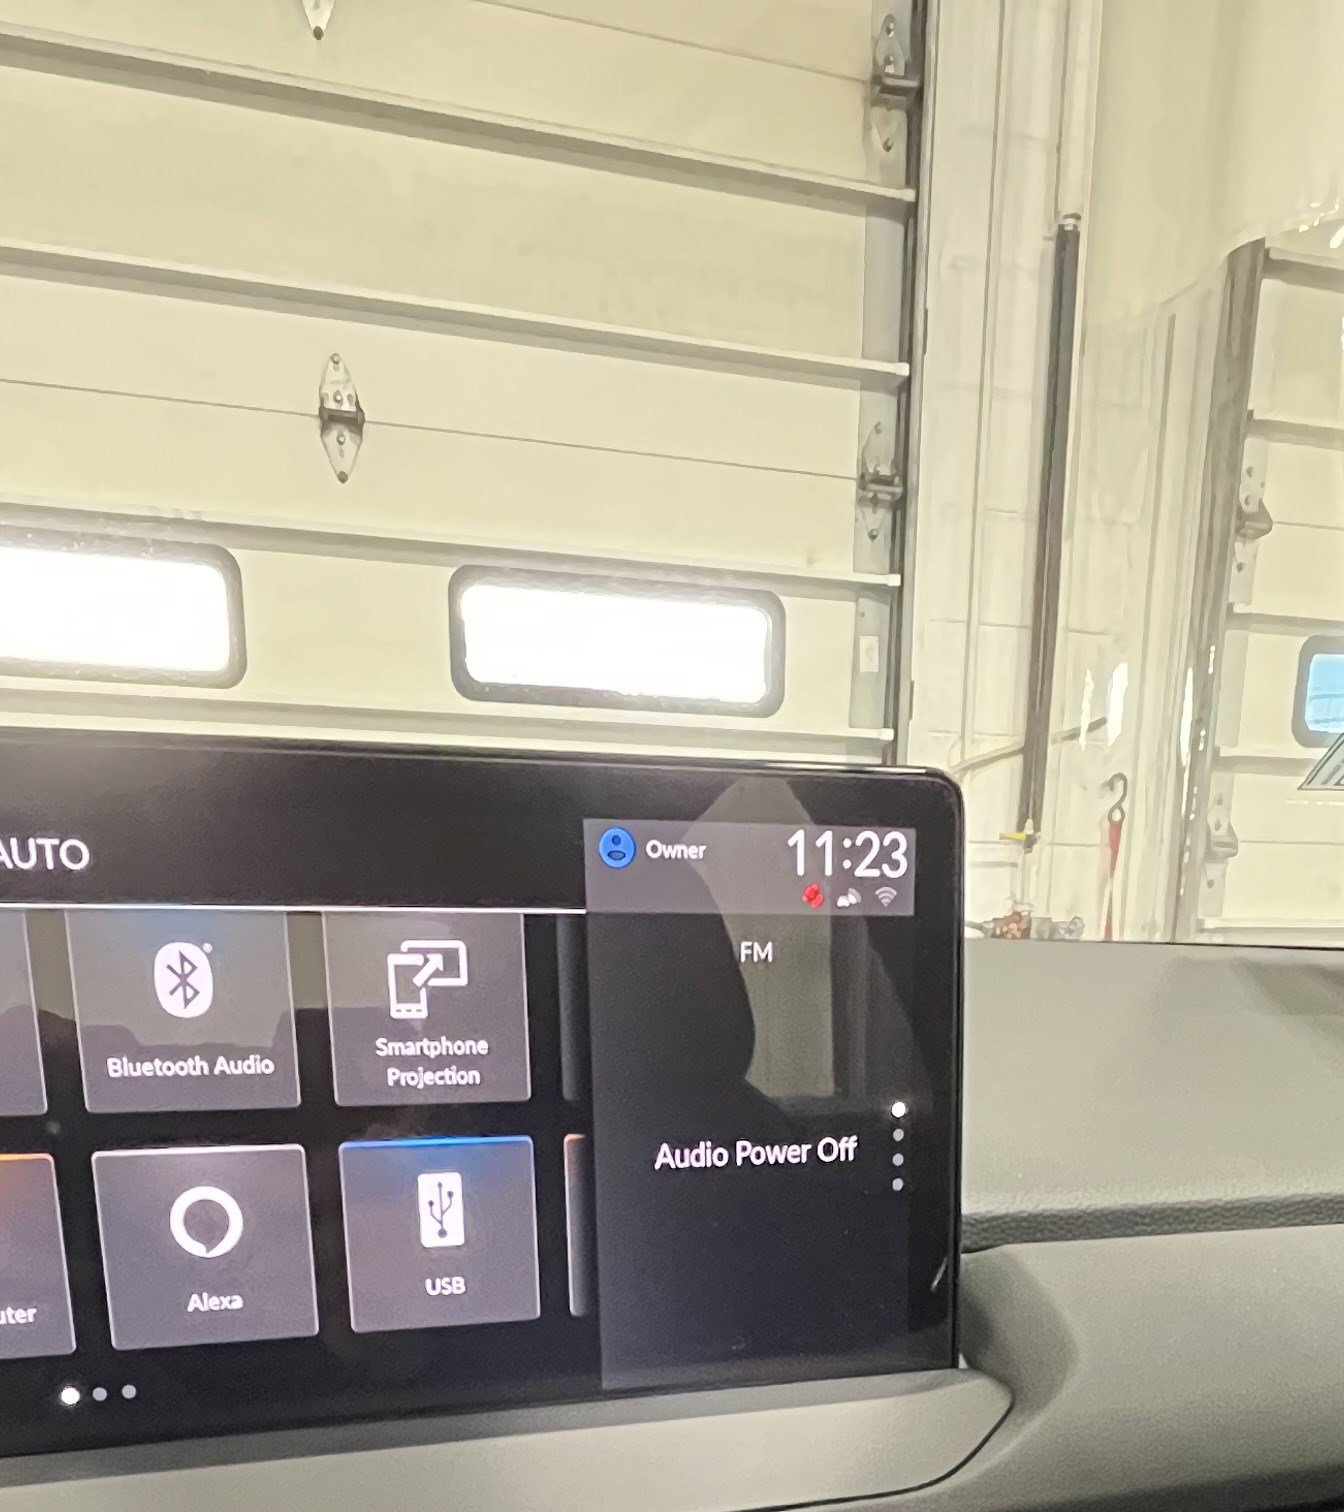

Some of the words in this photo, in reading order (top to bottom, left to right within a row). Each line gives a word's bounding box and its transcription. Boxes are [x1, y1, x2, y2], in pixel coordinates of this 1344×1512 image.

[645, 841, 706, 861] Owner
[787, 829, 908, 878] 11:23
[740, 941, 773, 962] FM
[375, 1038, 489, 1059] Smartphone
[107, 1057, 209, 1078] Bluetooth
[214, 1055, 275, 1076] Audio
[387, 1066, 481, 1087] Projection
[654, 1141, 729, 1170] Audio
[736, 1140, 809, 1166] Power
[817, 1135, 858, 1162] Off
[425, 1277, 465, 1296] USB
[187, 1292, 243, 1312] Alexa
